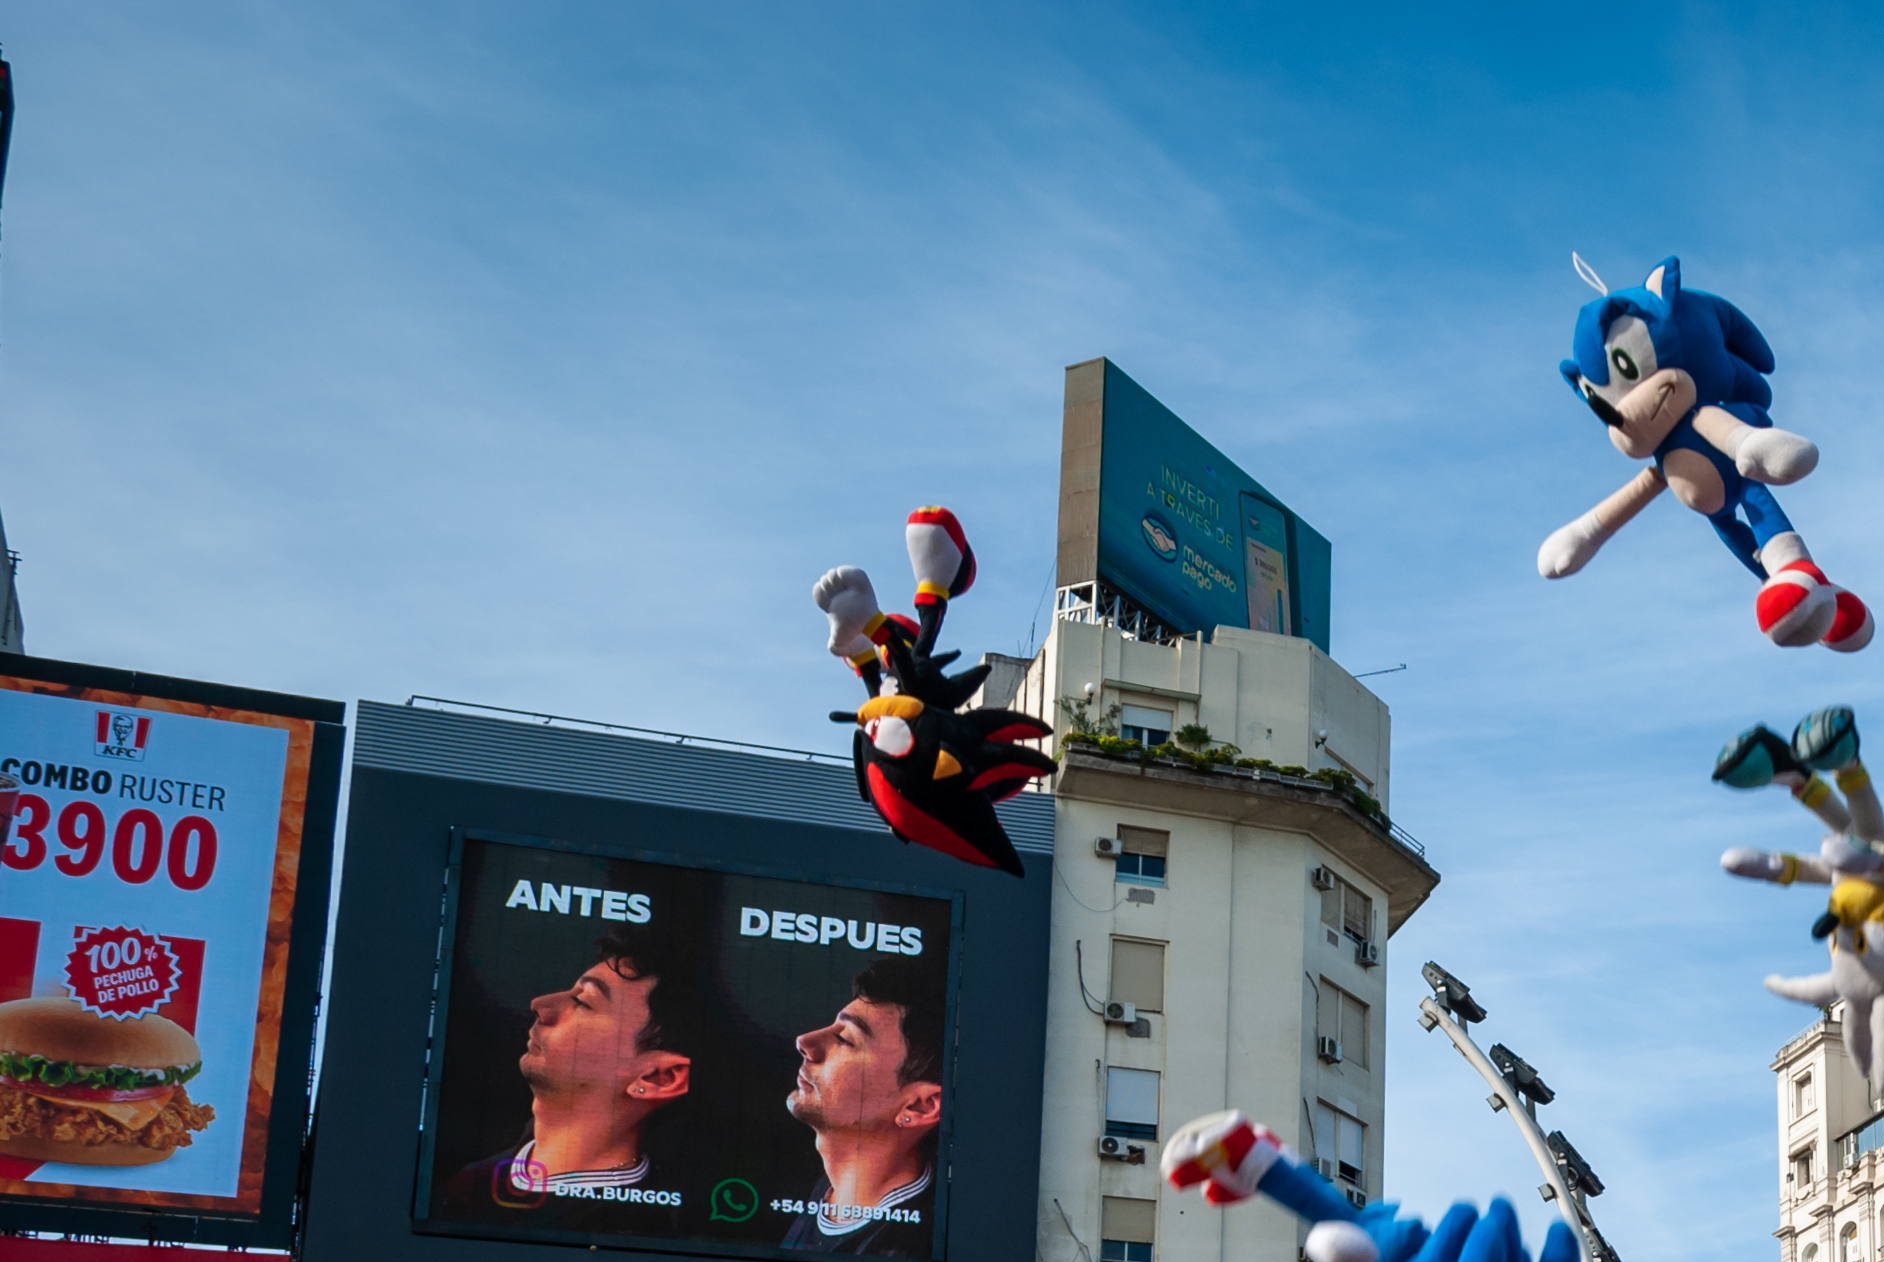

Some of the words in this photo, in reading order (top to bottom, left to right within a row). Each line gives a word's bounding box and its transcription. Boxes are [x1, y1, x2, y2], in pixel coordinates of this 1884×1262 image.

[1182, 545, 1237, 593] mercado
[1182, 561, 1212, 590] pago
[102, 745, 138, 759] KFC
[1, 757, 112, 795] COMBO
[119, 773, 226, 812] RUSTER
[1, 793, 218, 891] 3900
[505, 879, 652, 924] ANTES
[739, 906, 924, 957] DESPUES
[94, 965, 154, 989] PECHUGA
[98, 989, 116, 1004] DE
[117, 978, 159, 1001] POLLO
[555, 1184, 682, 1206] DRA.BURGOS
[770, 1198, 804, 1213] +54
[807, 1200, 819, 1215] 9
[823, 1202, 838, 1217] 11
